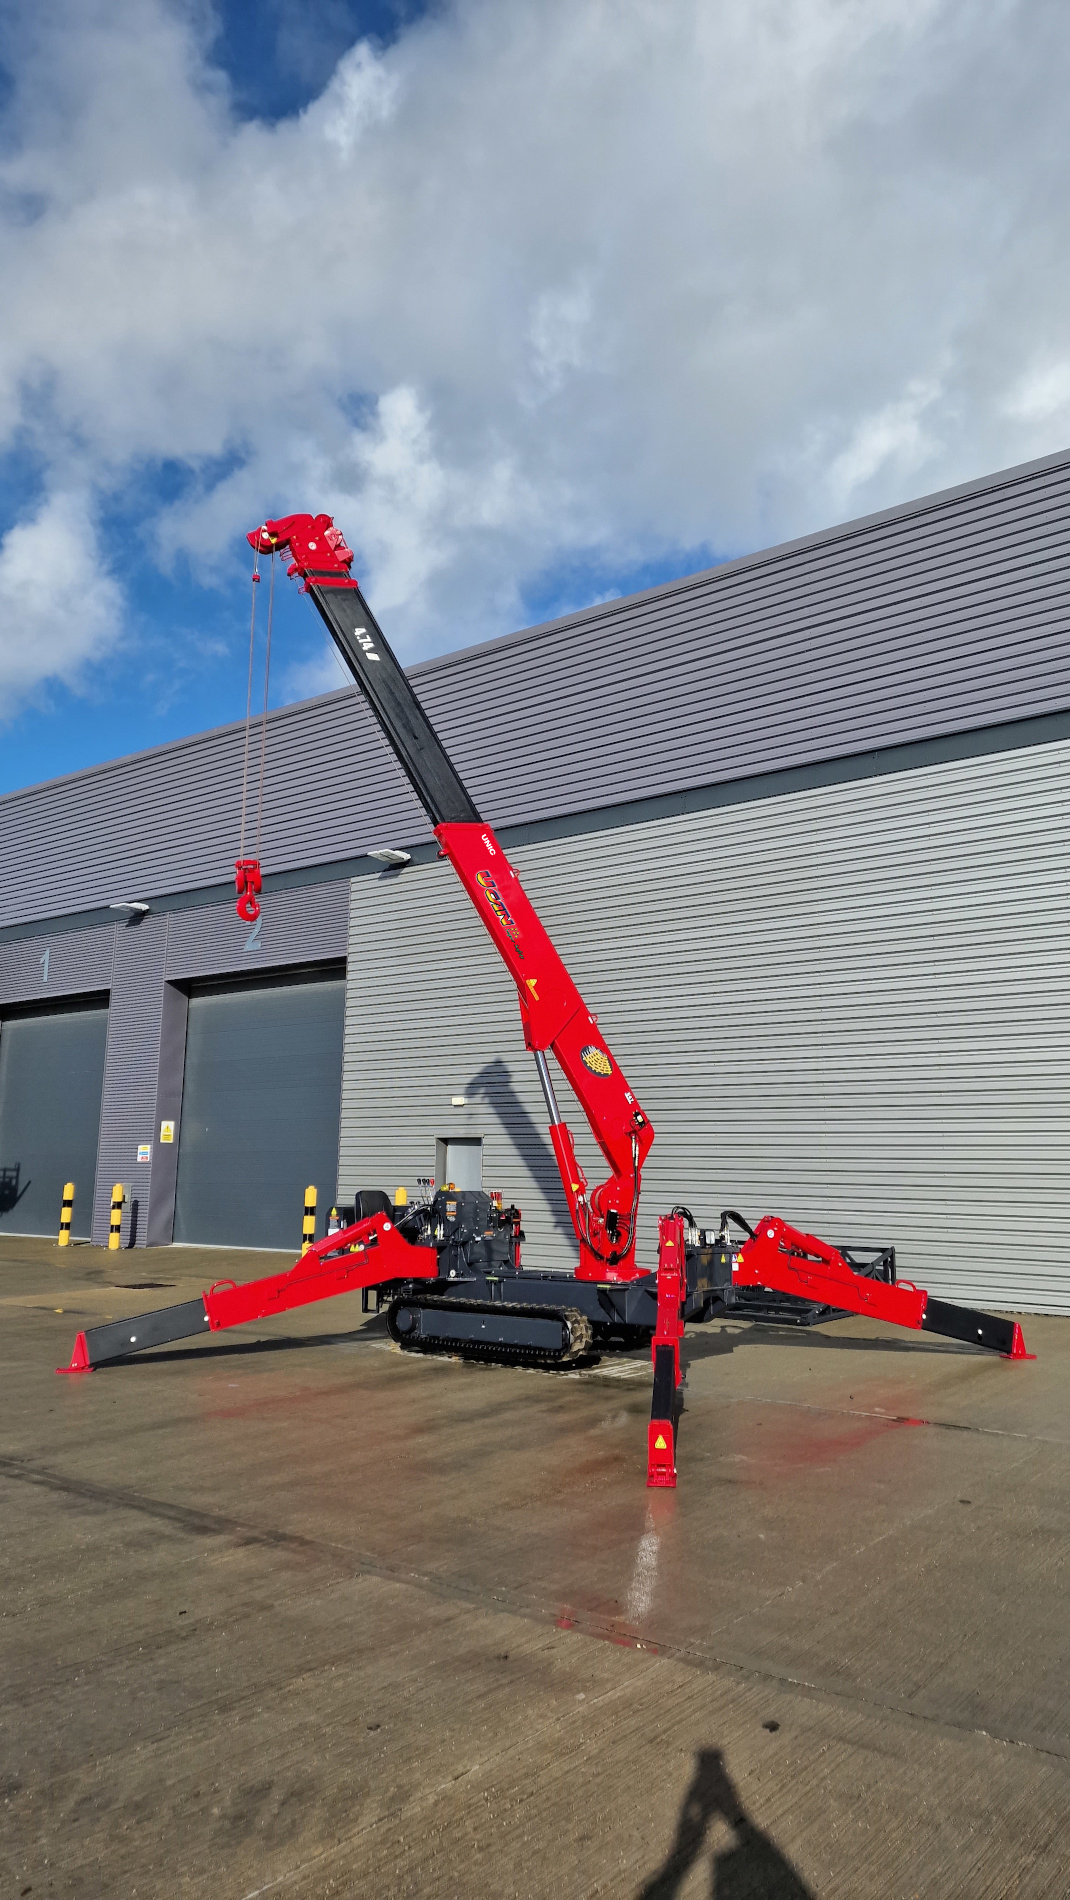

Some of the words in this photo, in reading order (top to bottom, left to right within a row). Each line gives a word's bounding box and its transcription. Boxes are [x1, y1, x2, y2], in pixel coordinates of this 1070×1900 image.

[481, 833, 496, 856] UNIC
[244, 914, 263, 951] 2
[40, 946, 50, 982] 1
